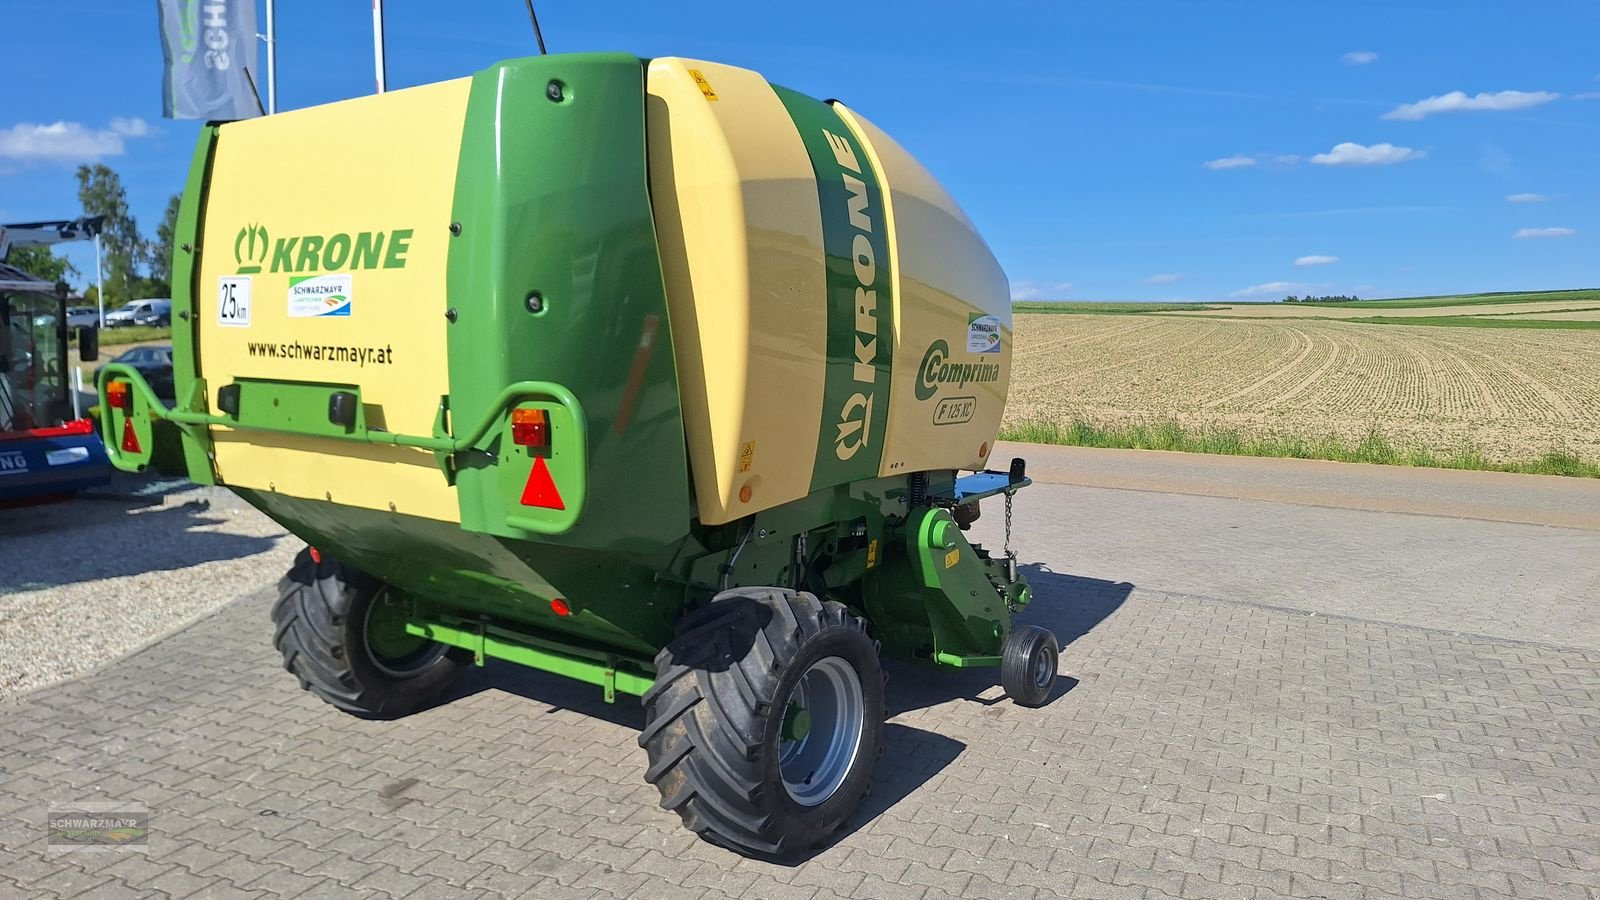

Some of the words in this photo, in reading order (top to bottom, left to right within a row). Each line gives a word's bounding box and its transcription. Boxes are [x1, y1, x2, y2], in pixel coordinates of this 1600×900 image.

[203, 0, 230, 71] SCH
[270, 229, 414, 273] KRONE
[822, 128, 877, 384] KRONE
[221, 283, 237, 319] 25
[237, 304, 247, 320] km
[293, 285, 343, 295] SCHWARZMAYR
[248, 340, 393, 368] www.schwarzmayr.at
[937, 404, 947, 419] F
[948, 403, 961, 418] 125
